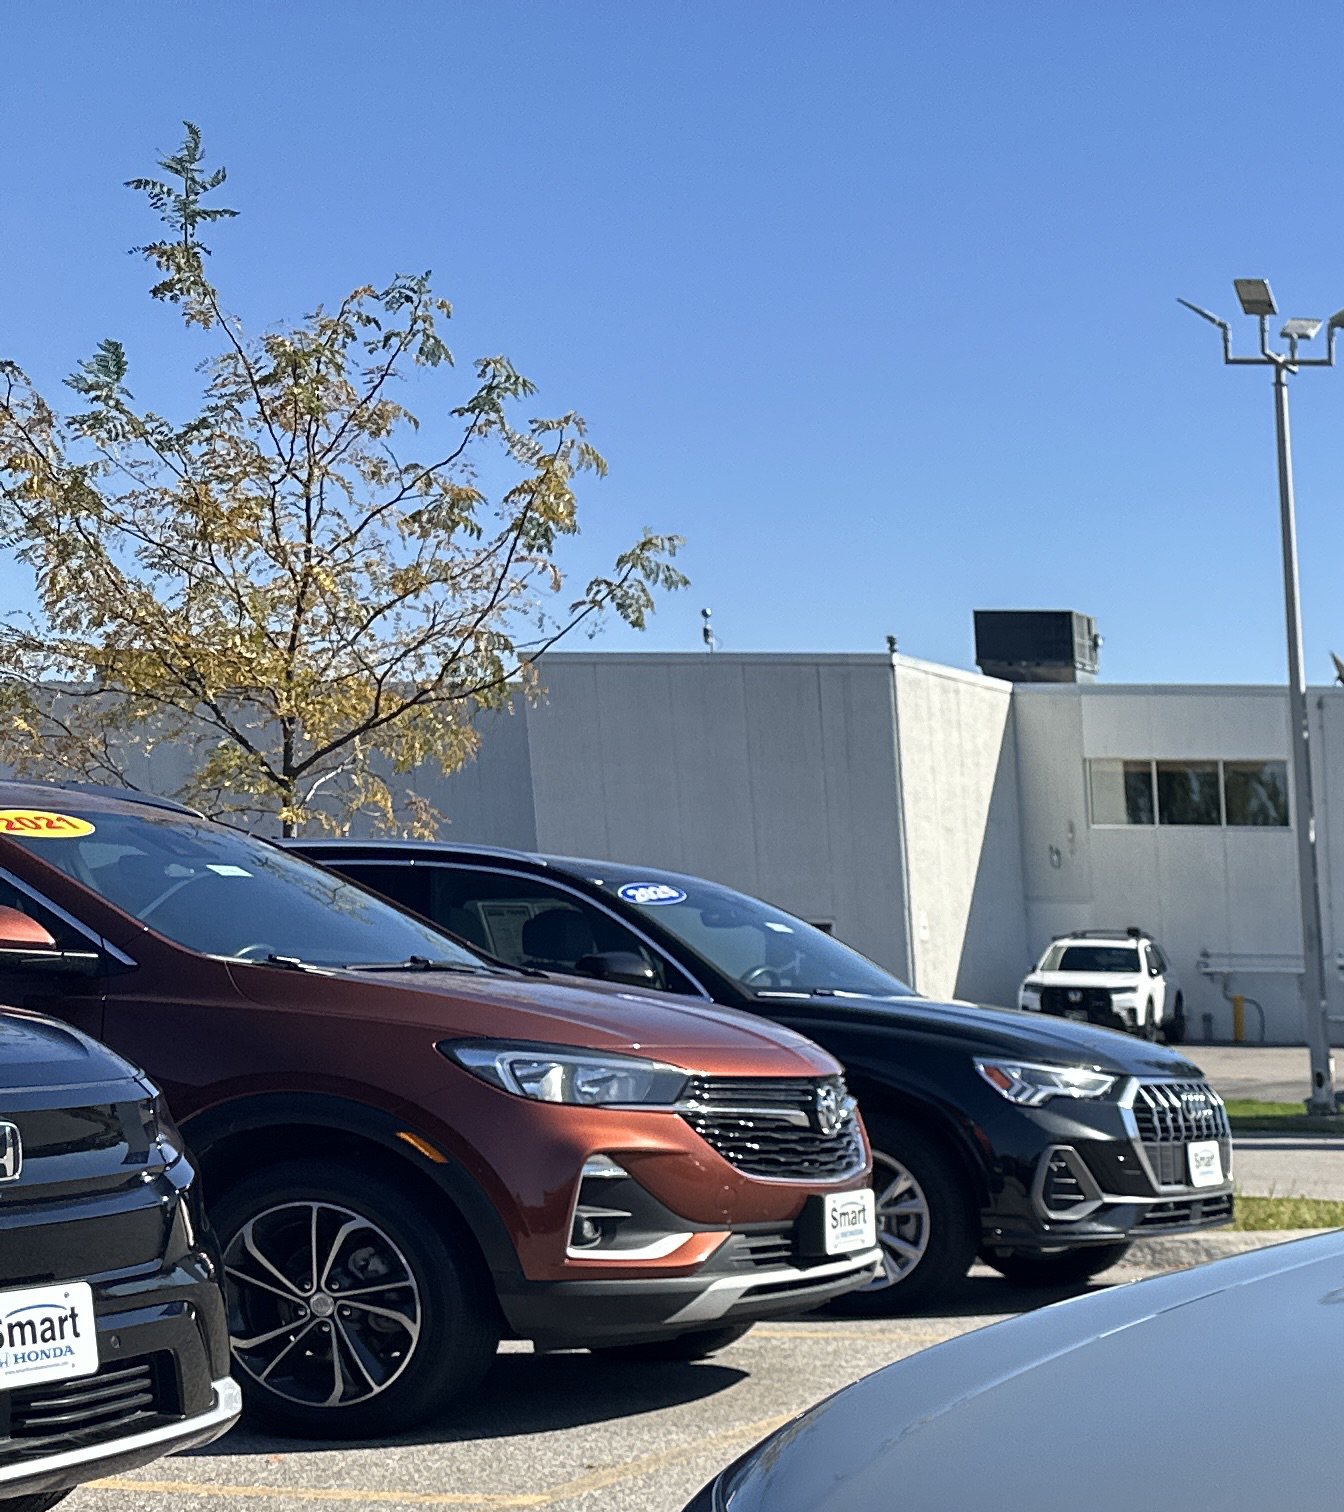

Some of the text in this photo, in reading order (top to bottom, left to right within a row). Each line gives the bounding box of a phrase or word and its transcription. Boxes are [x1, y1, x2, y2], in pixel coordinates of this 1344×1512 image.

[0, 816, 80, 831] 2021
[831, 1204, 868, 1229] Smart
[13, 1345, 76, 1365] HONDA
